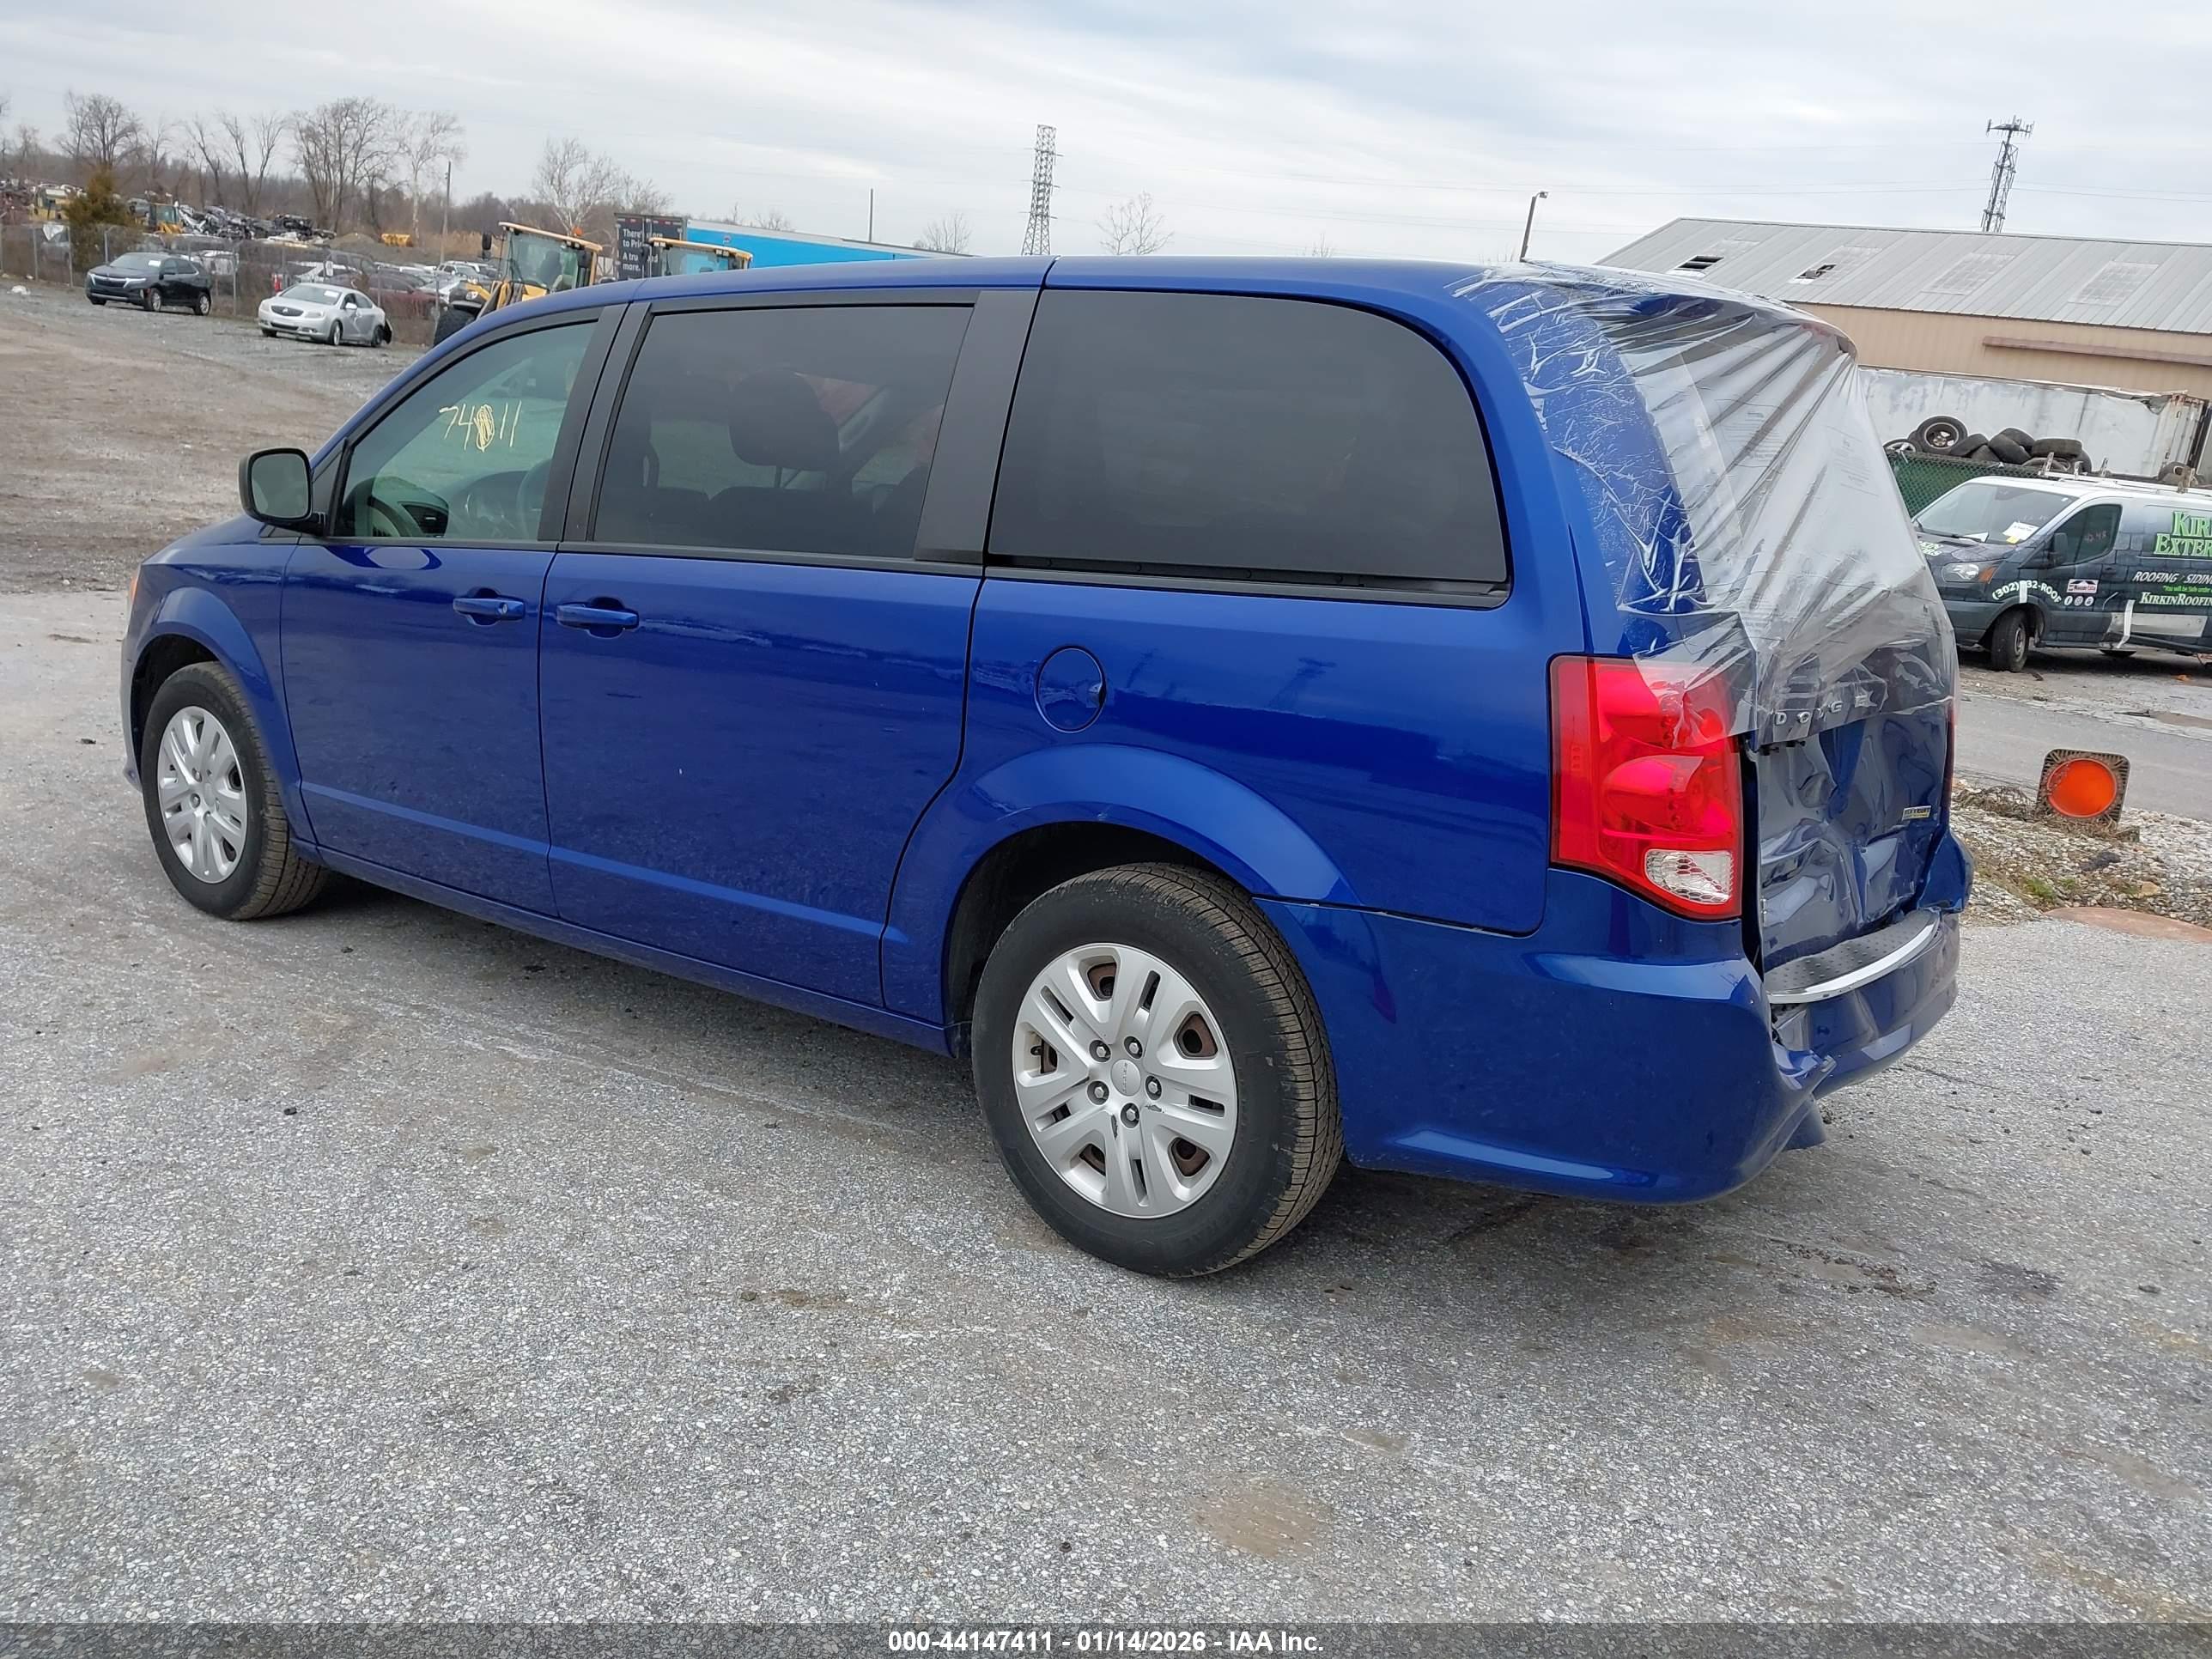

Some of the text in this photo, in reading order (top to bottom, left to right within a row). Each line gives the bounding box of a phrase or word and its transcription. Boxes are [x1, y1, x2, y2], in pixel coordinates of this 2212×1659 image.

[623, 240, 630, 248] to
[623, 252, 628, 261] A
[2132, 571, 2179, 583] ROOFING
